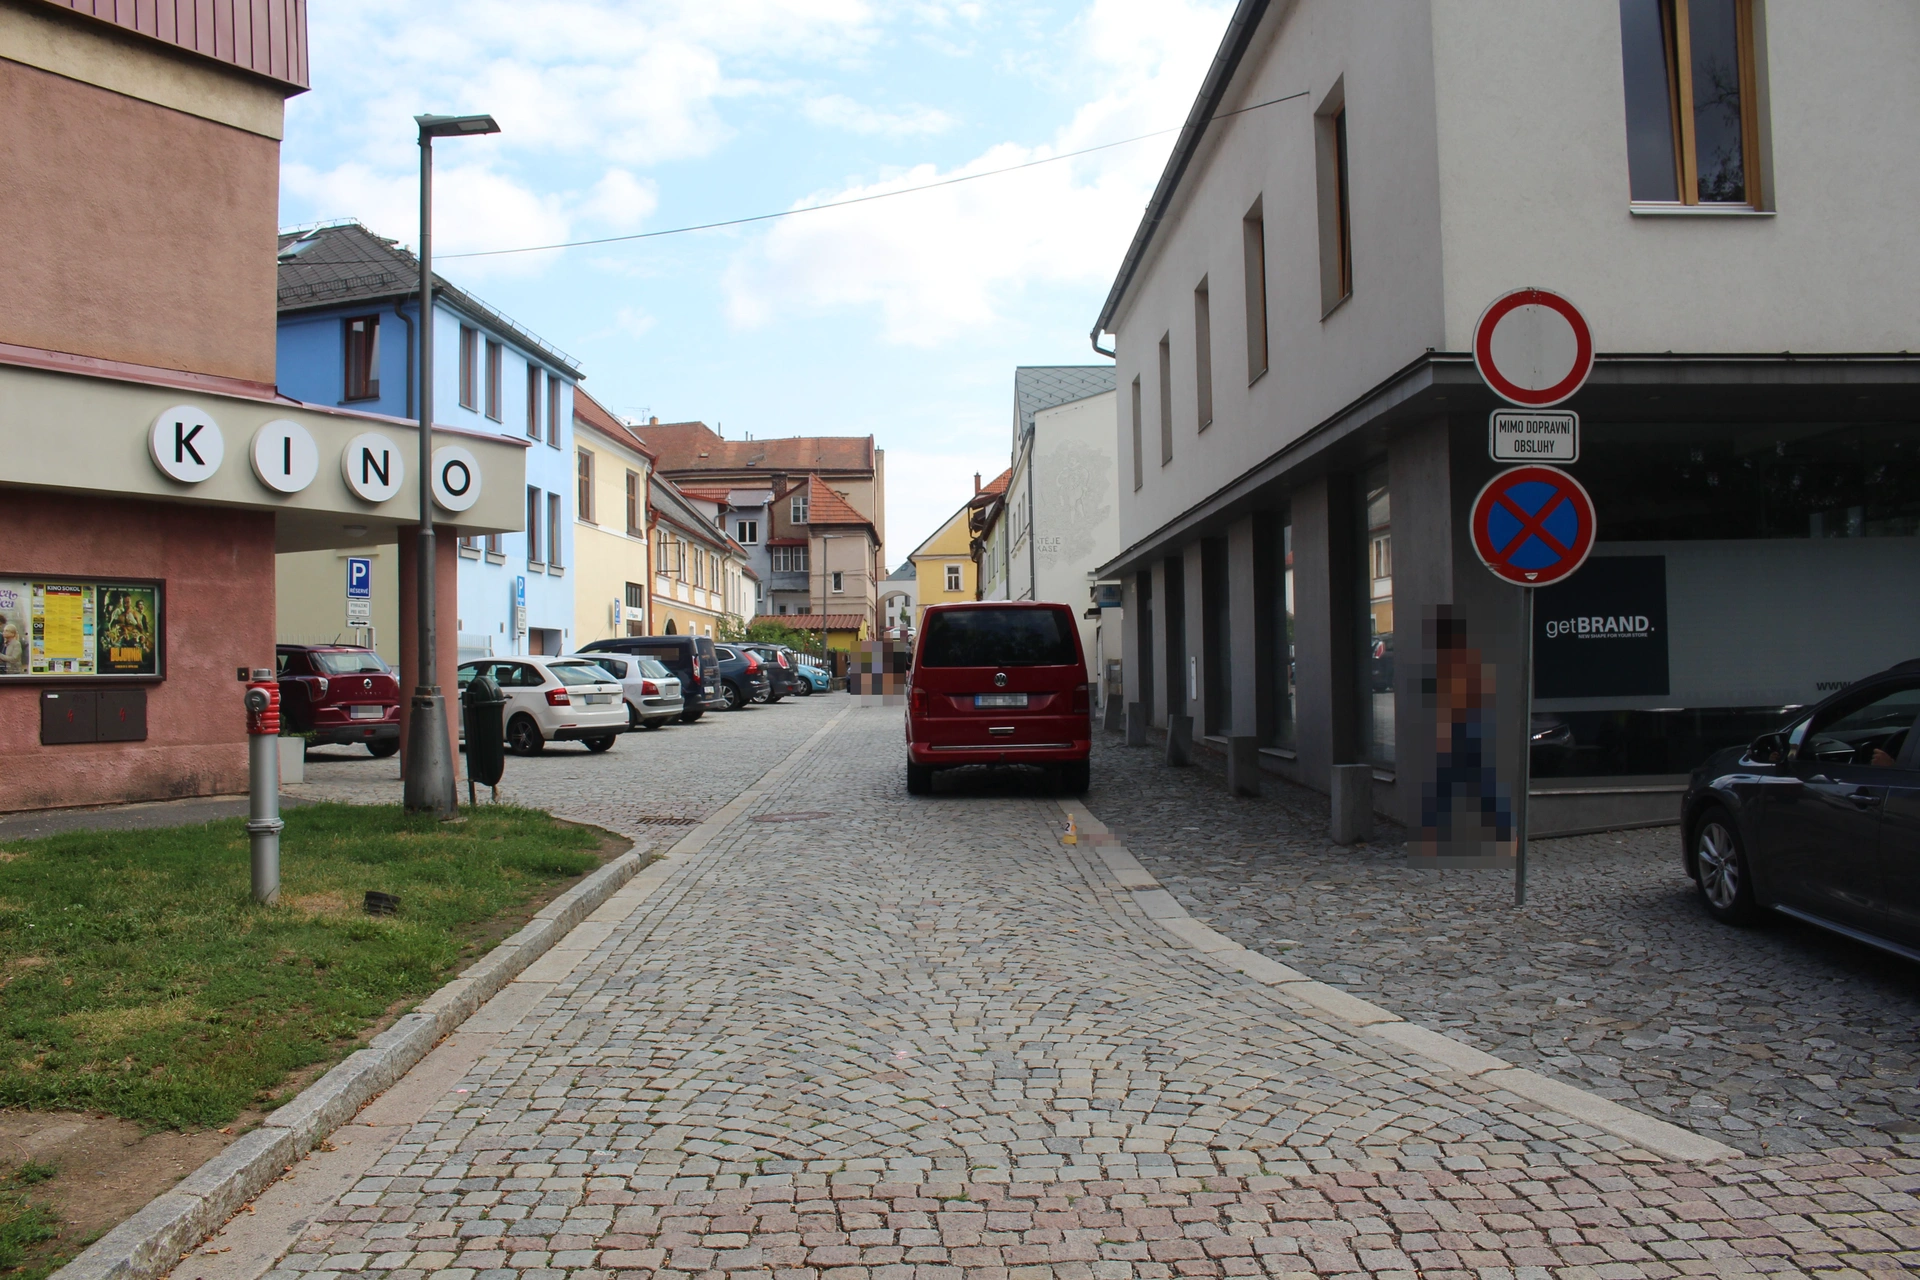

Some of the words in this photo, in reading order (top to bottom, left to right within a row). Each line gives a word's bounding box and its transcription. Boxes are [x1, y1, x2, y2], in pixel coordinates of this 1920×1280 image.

[1499, 419, 1524, 433] MIMO
[1526, 418, 1571, 434] DOPRAVNÍ
[1514, 439, 1555, 453] OBSLUHY
[174, 421, 471, 497] KINO
[352, 562, 366, 586] P
[1546, 615, 1655, 638] getBRAND.
[1065, 822, 1070, 831] 2
